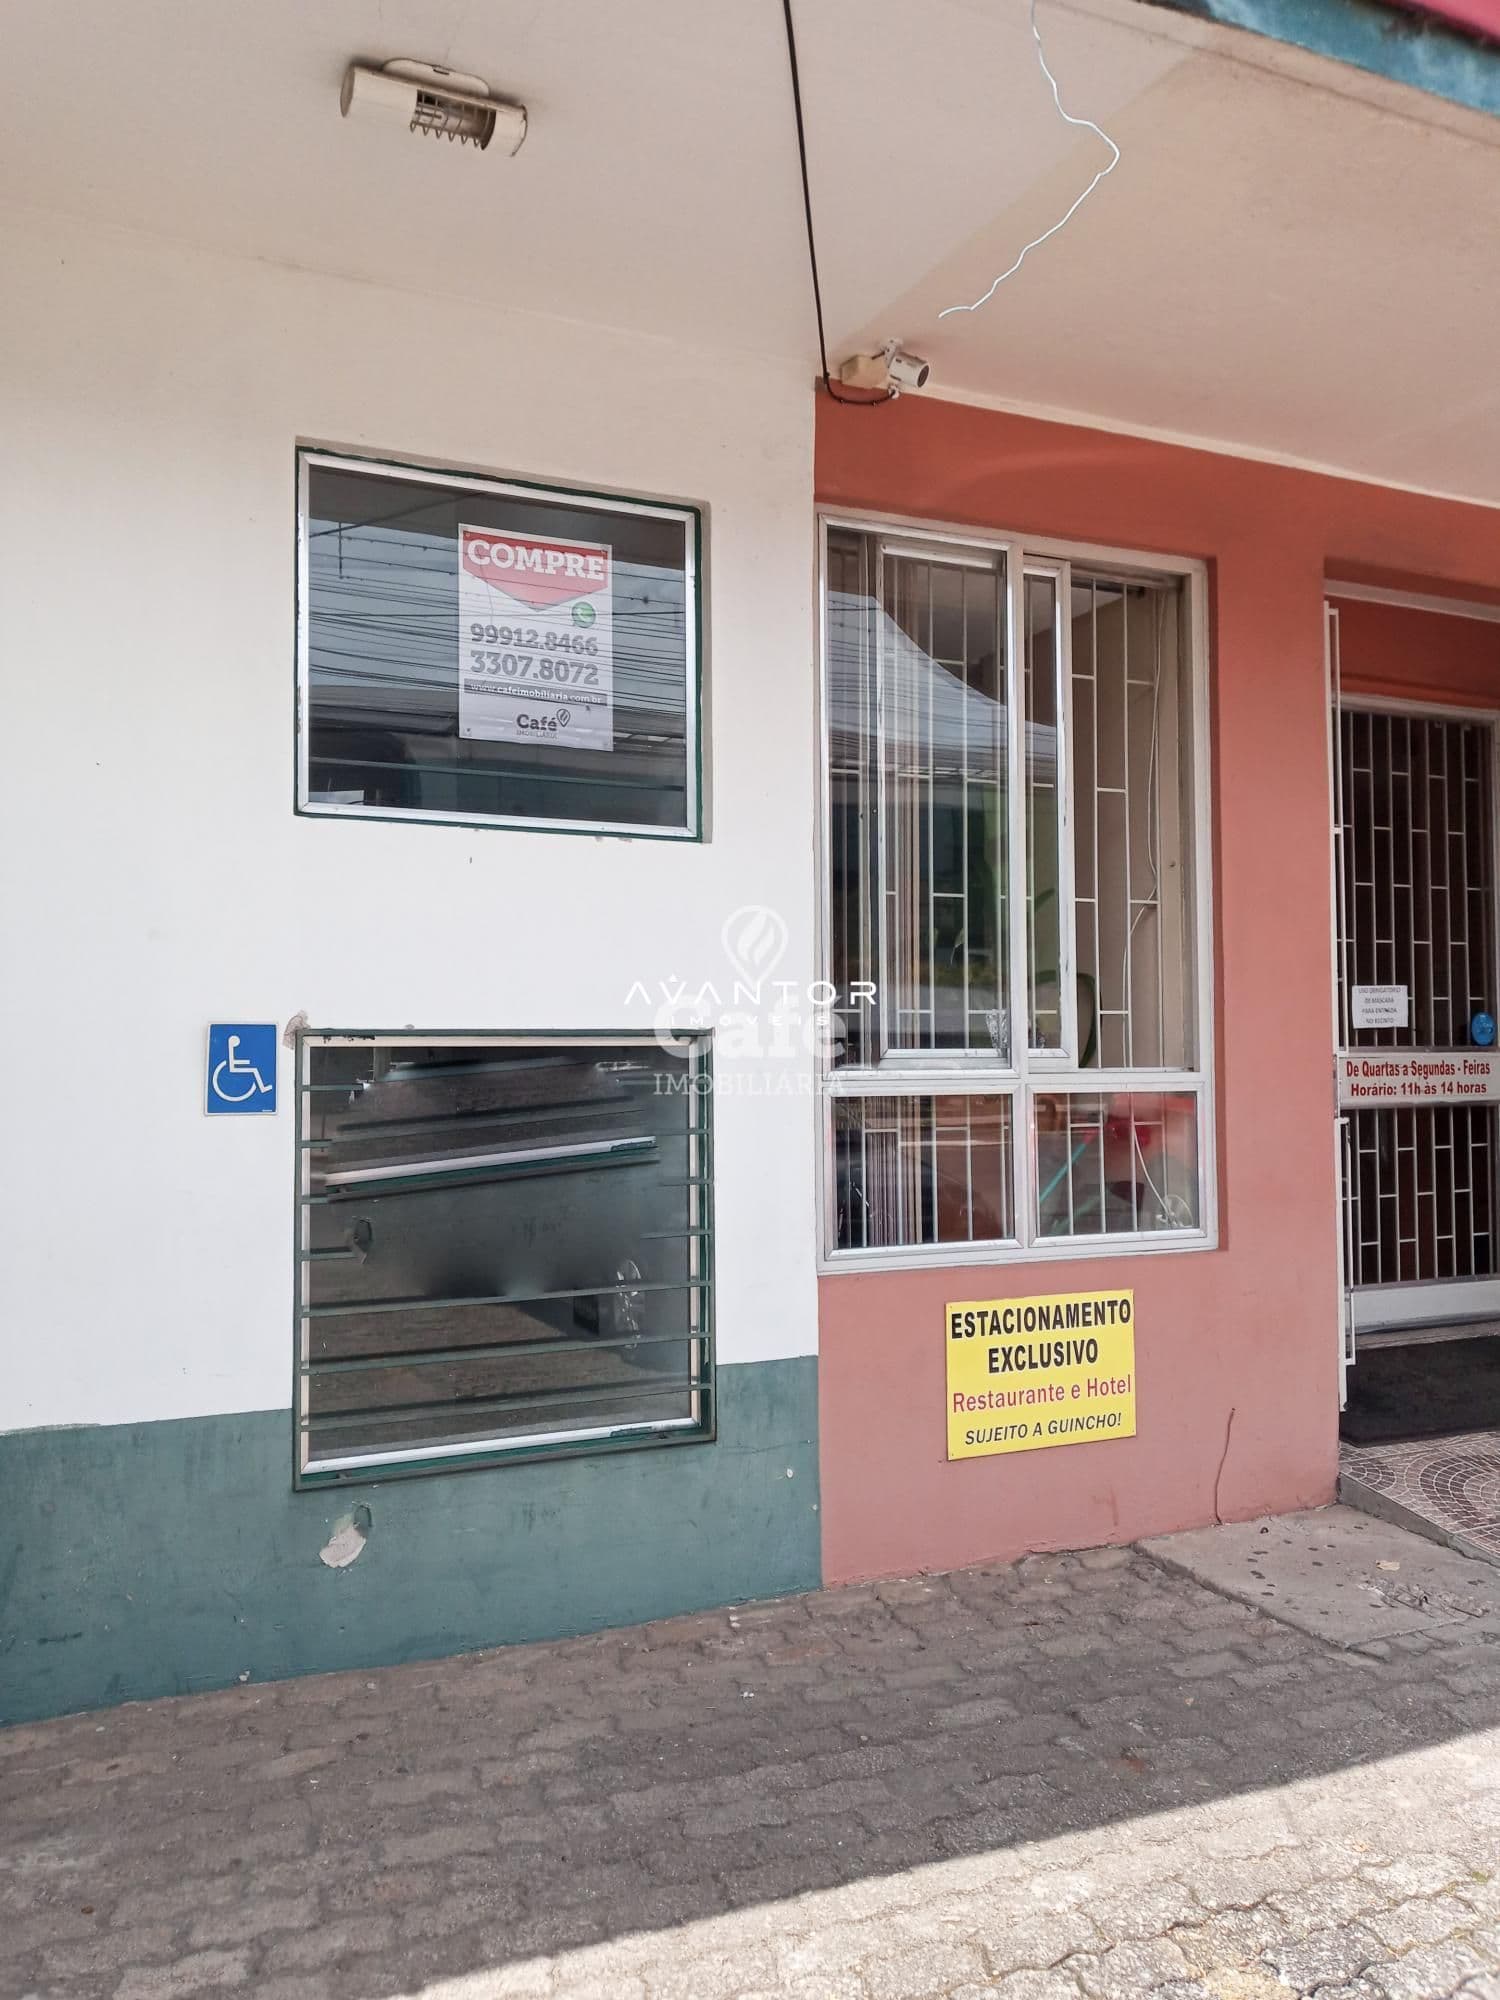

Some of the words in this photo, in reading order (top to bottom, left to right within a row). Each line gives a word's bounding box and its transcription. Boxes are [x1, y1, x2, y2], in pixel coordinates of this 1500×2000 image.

[467, 539, 604, 579] COMPRE
[470, 623, 599, 656] 99912.8466
[470, 650, 599, 686] 3307.8072
[516, 713, 558, 732] Café
[1347, 1061, 1359, 1077] De
[1362, 1061, 1400, 1077] Quartas
[1402, 1065, 1408, 1076] a
[1411, 1060, 1455, 1079] Segundas
[1463, 1059, 1490, 1074] Feiras
[1351, 1083, 1397, 1096] Horário:
[1401, 1082, 1421, 1095] 11h
[1441, 1081, 1453, 1094] 14
[1457, 1081, 1487, 1094] horas
[951, 1299, 1131, 1339] ESTACIONAMENTO
[988, 1338, 1098, 1374] EXCLUSIVO
[953, 1383, 1065, 1413] Restaurante
[1071, 1383, 1081, 1399] e
[1087, 1374, 1131, 1398] Hotel
[965, 1424, 1028, 1445] SUJEITO
[1032, 1422, 1043, 1437] A
[1048, 1412, 1122, 1435] GUINCHO!
